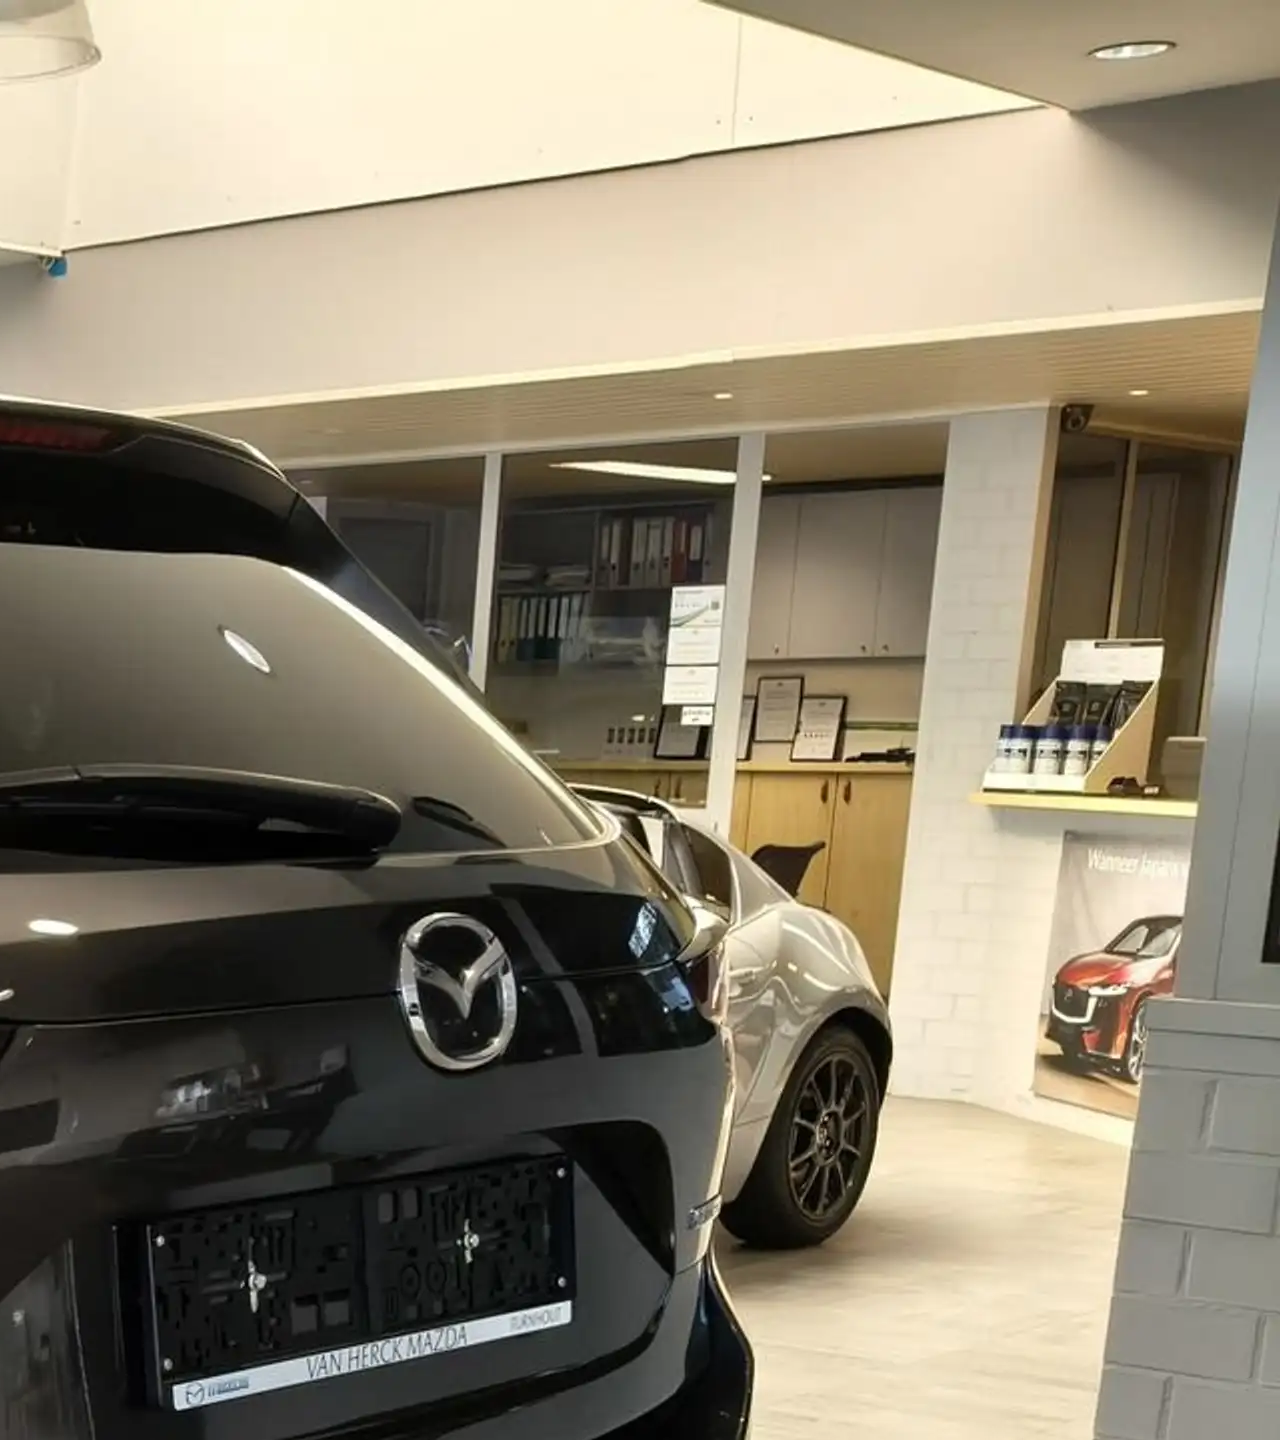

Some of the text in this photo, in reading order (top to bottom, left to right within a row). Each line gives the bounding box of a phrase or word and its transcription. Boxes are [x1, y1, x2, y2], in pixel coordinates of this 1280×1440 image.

[306, 1354, 342, 1380] VAN
[347, 1339, 403, 1372] HERCK
[406, 1325, 469, 1359] MAZDA
